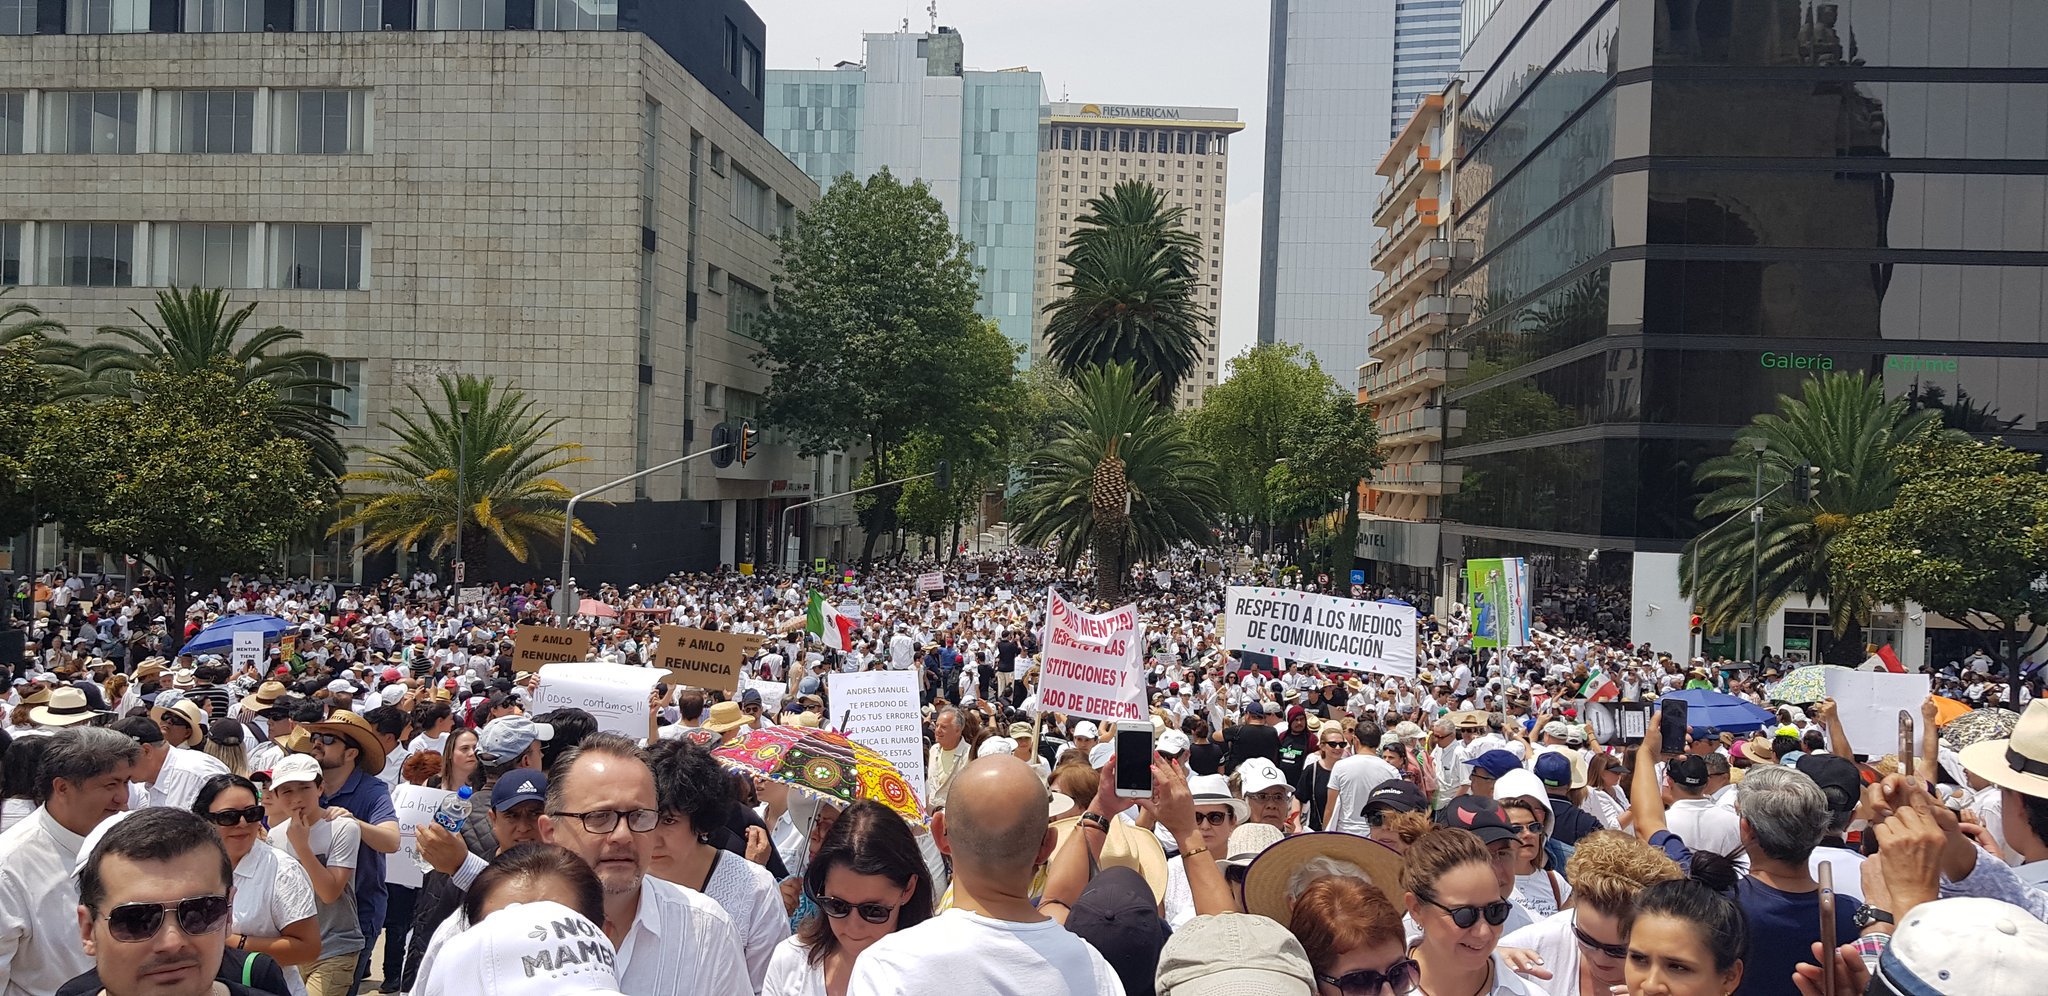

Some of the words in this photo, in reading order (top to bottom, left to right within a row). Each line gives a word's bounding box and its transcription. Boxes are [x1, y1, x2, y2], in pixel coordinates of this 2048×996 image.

[1760, 352, 1834, 370] Galería
[1887, 355, 1958, 372] Afirme
[1234, 598, 1300, 622] RESPETO
[1302, 606, 1312, 624] A
[1316, 608, 1346, 630] LOS
[1348, 613, 1402, 638] MEDIOS
[532, 634, 540, 643] #
[542, 636, 573, 646] AMLO
[678, 637, 686, 648] #
[689, 638, 725, 653] AMLO
[1104, 640, 1125, 656] LAS
[1247, 620, 1268, 640] DE
[1270, 624, 1384, 658] COMUNICACIÓN
[521, 650, 578, 663] RENUNCIA
[665, 656, 731, 676] RENUNCIA
[1046, 658, 1117, 686] STITUCIONES
[1121, 671, 1127, 687] Y
[846, 687, 876, 695] ANDRES
[1042, 688, 1066, 708] ADO
[1068, 693, 1084, 711] DE
[1086, 697, 1142, 720] DERECHO.
[861, 725, 891, 733] PASADO
[400, 792, 414, 808] La
[418, 796, 438, 813] hist
